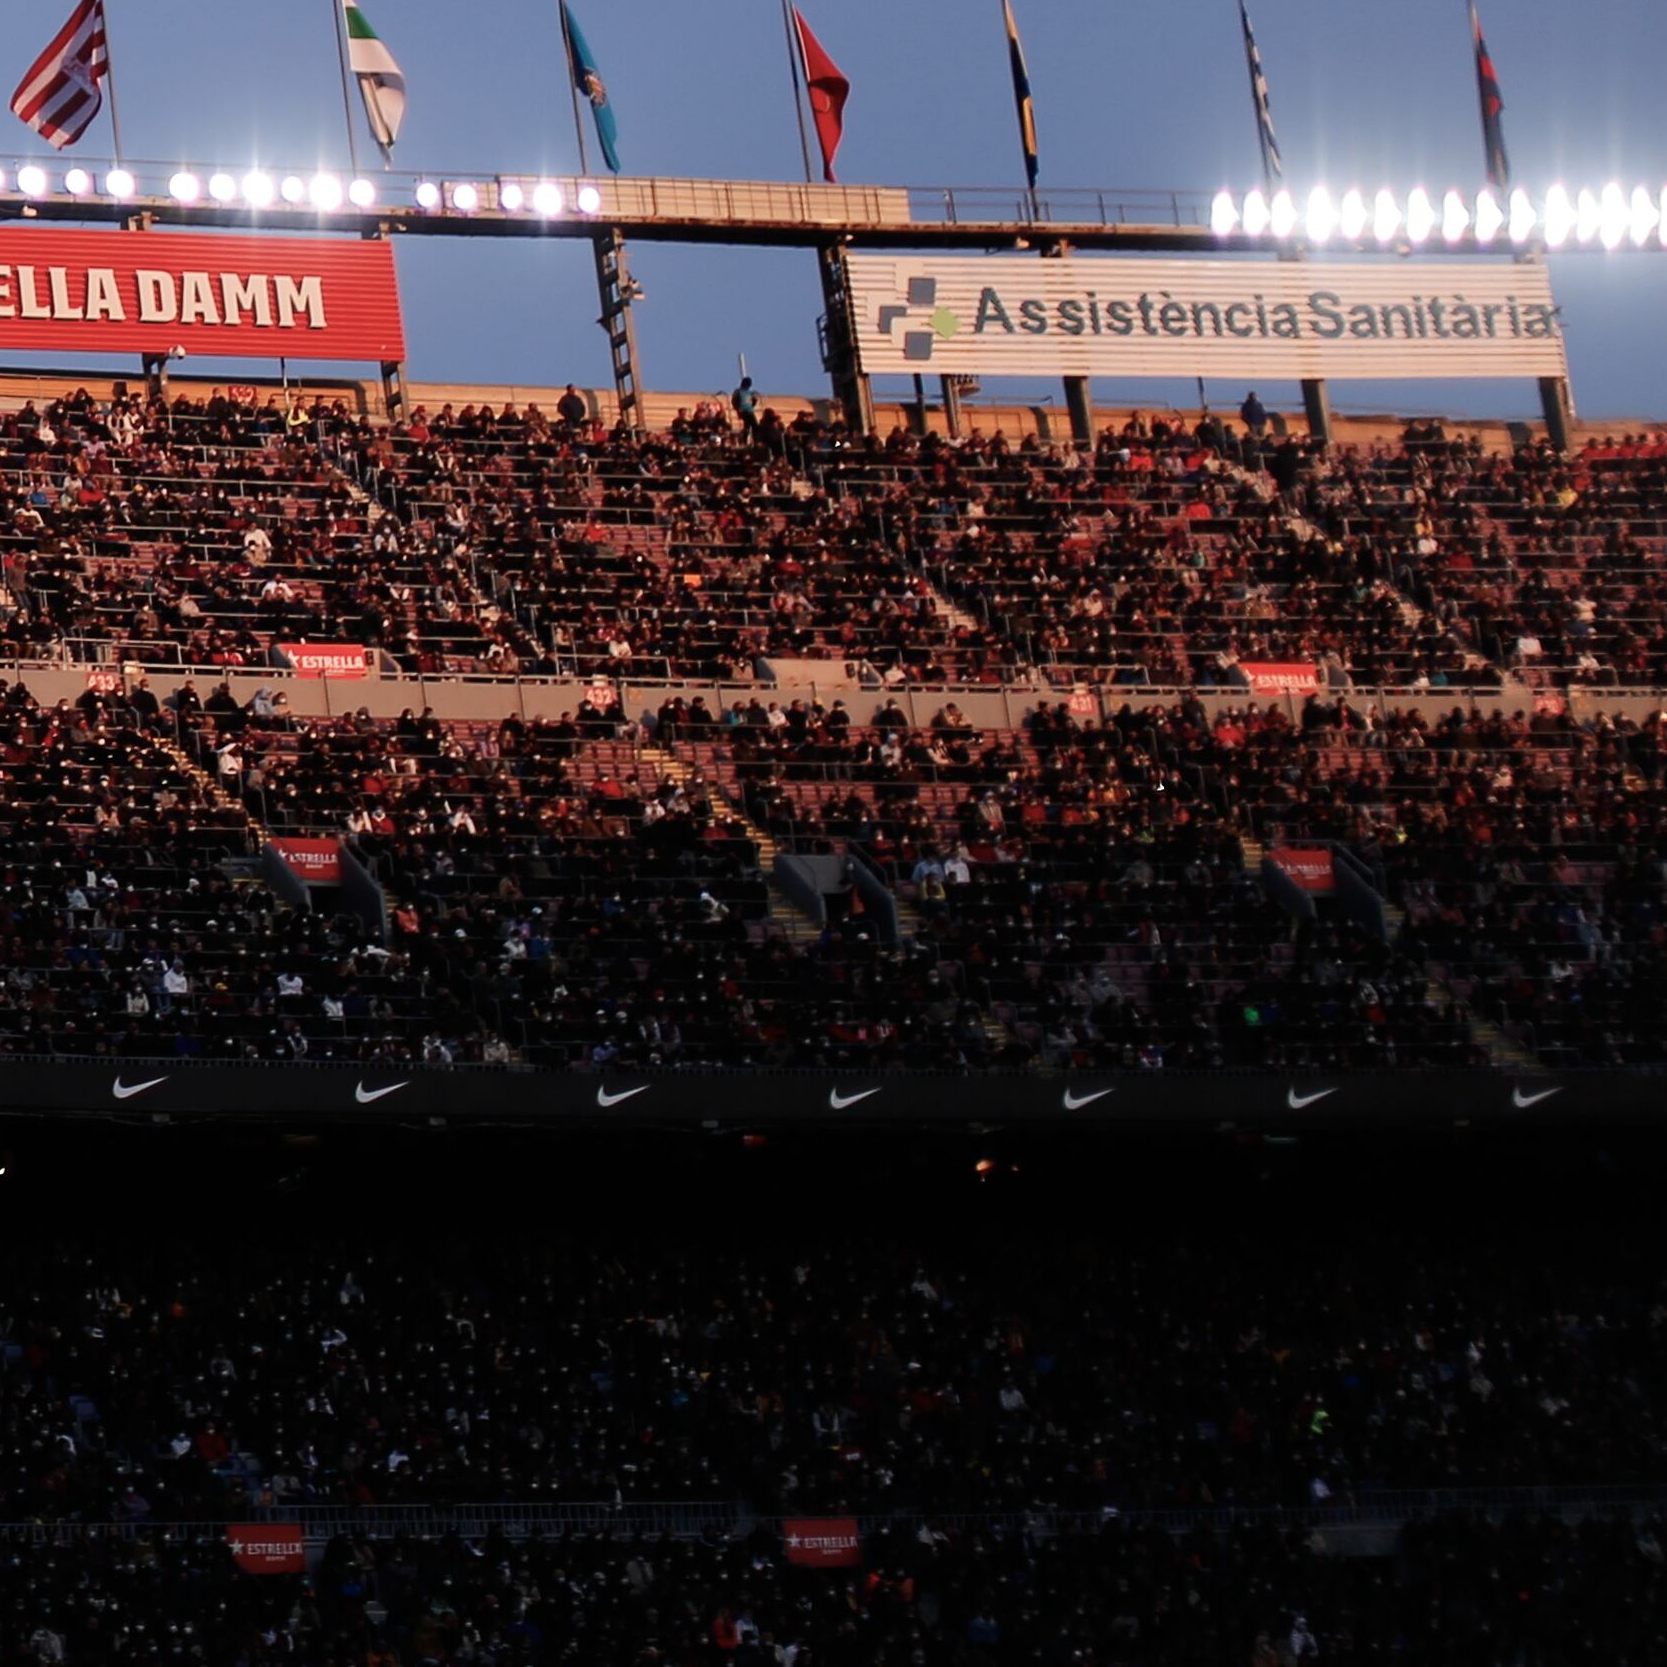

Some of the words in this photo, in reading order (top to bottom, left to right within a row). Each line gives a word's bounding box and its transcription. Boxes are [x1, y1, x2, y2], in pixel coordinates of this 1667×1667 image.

[135, 268, 327, 329] DAMM
[301, 656, 364, 669] ESTRELLA
[247, 1542, 303, 1555] ESTRELLA
[804, 1536, 858, 1549] ESTRELLA
